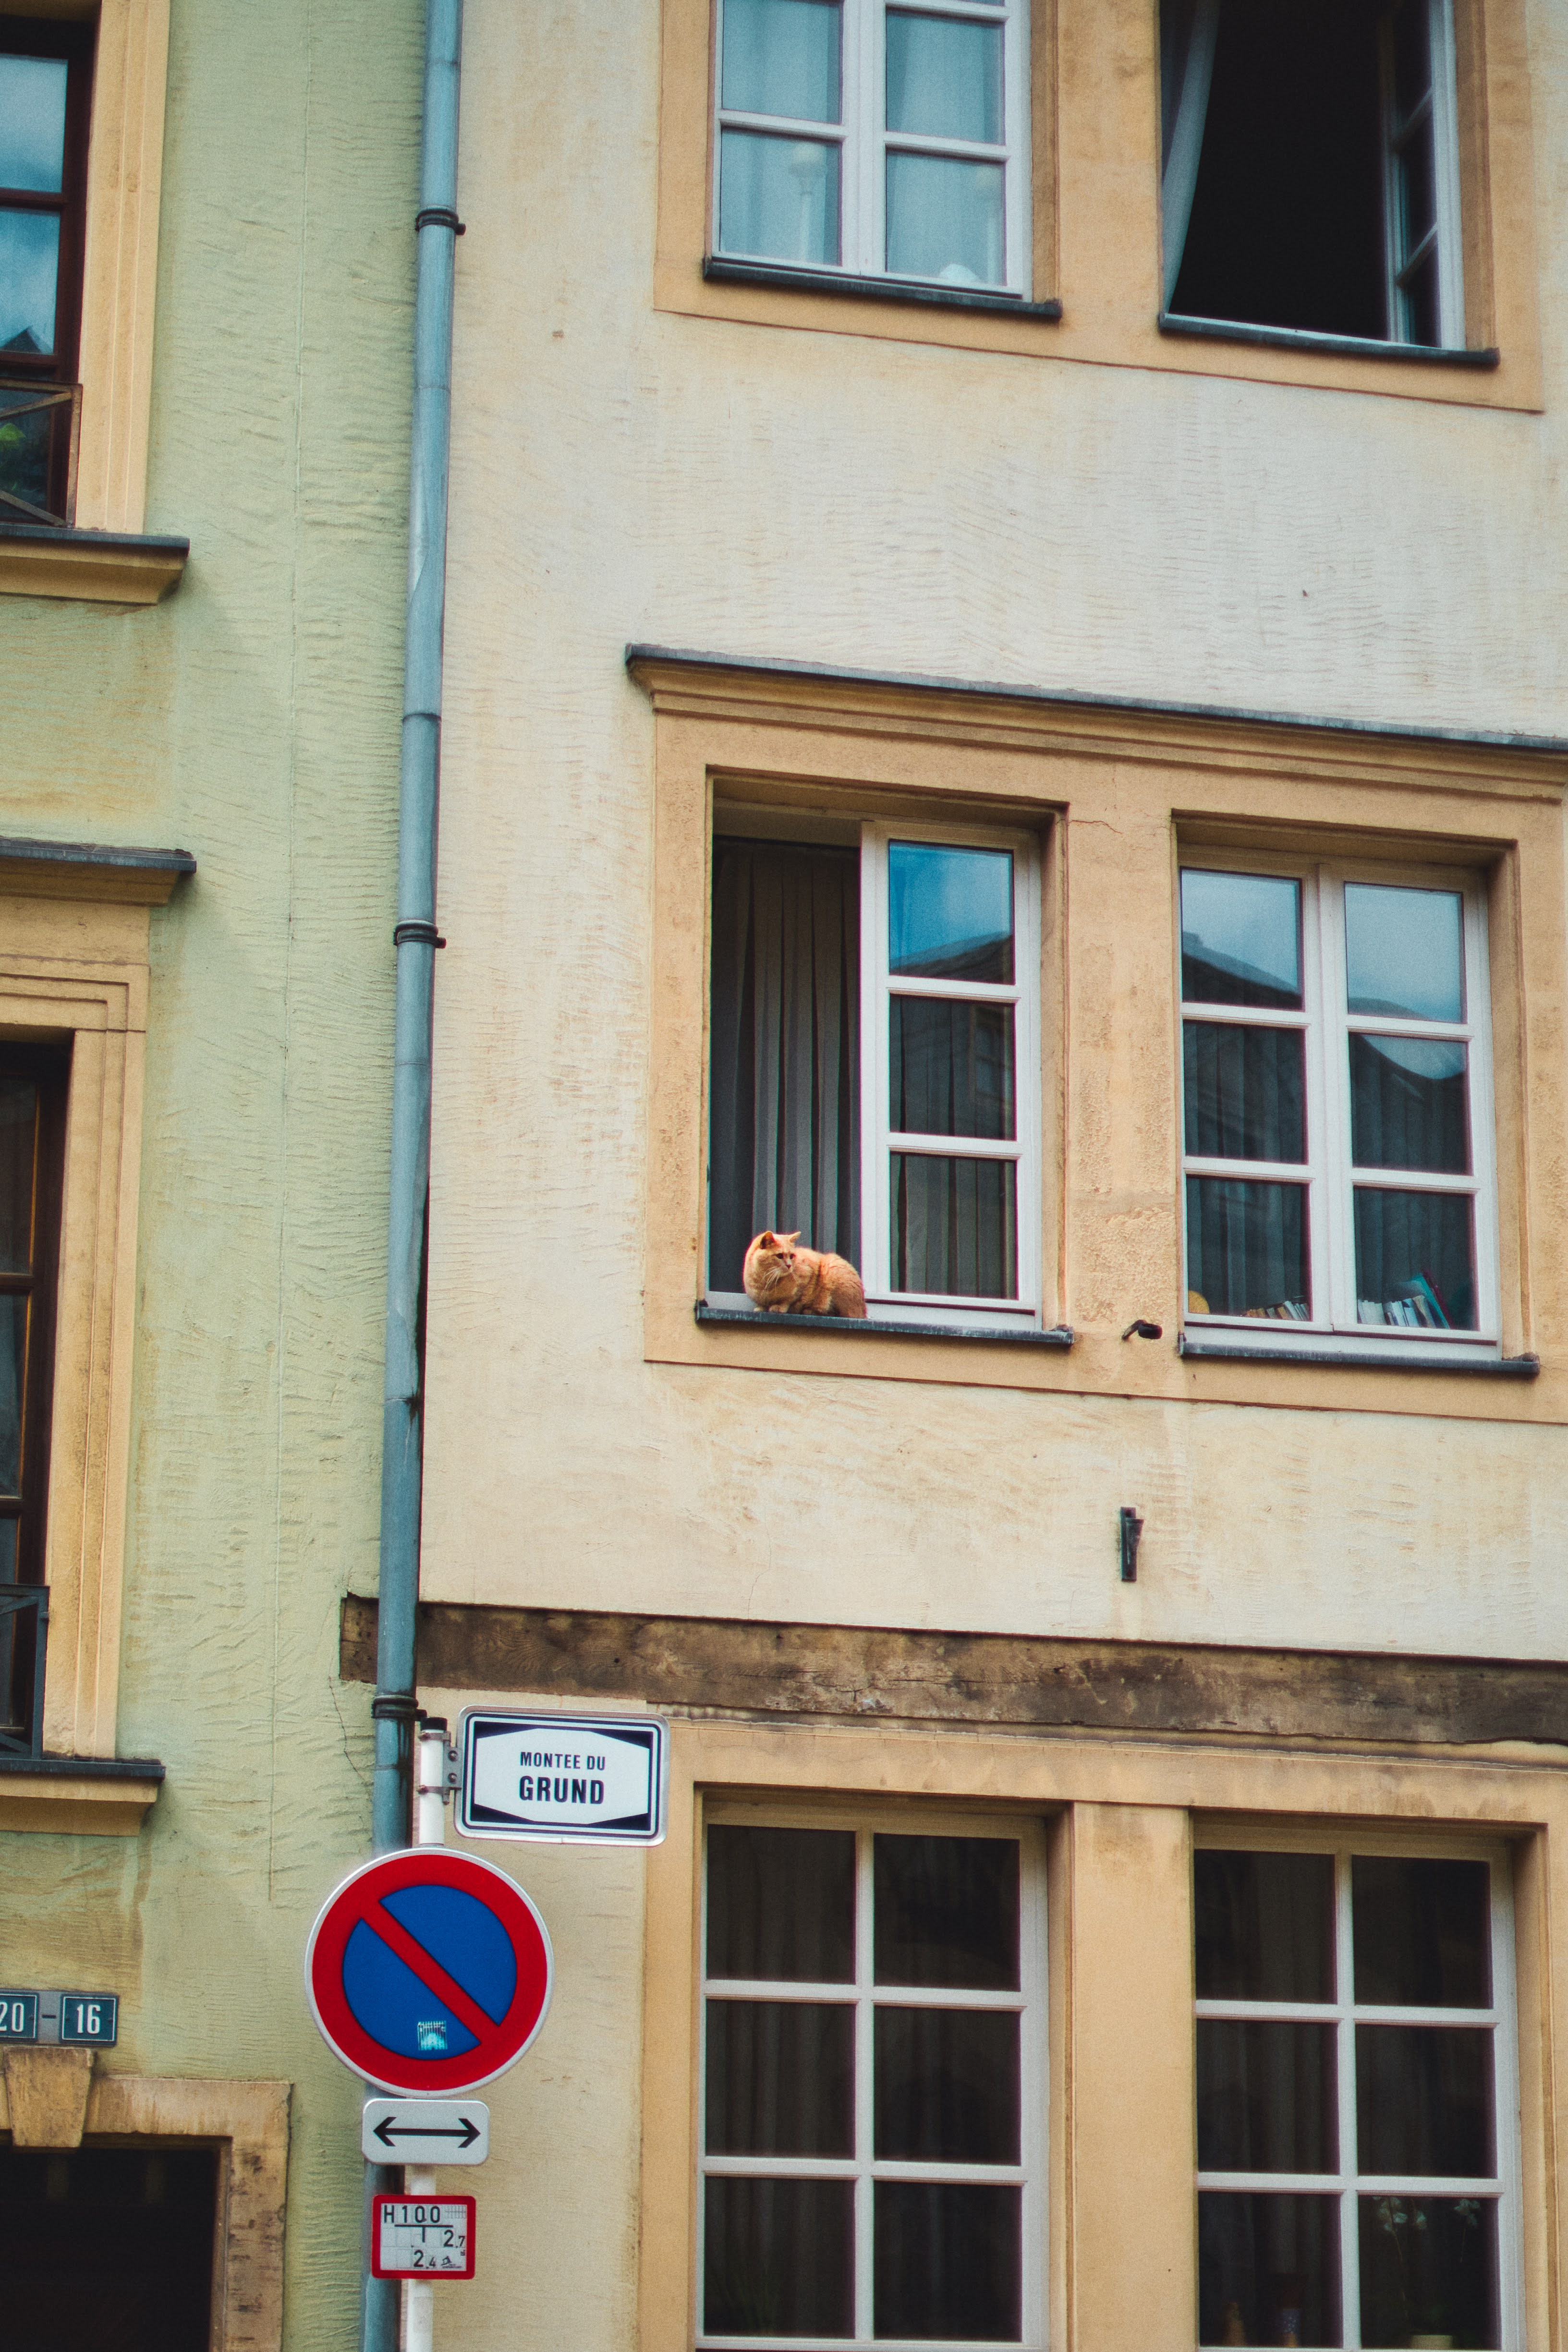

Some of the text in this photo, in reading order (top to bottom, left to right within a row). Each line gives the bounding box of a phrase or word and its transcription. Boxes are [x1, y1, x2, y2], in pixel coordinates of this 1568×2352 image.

[520, 1751, 606, 1771] MONTEE DU
[519, 1775, 604, 1805] GRUND
[0, 2001, 24, 2032] 20
[76, 2003, 101, 2034] 16
